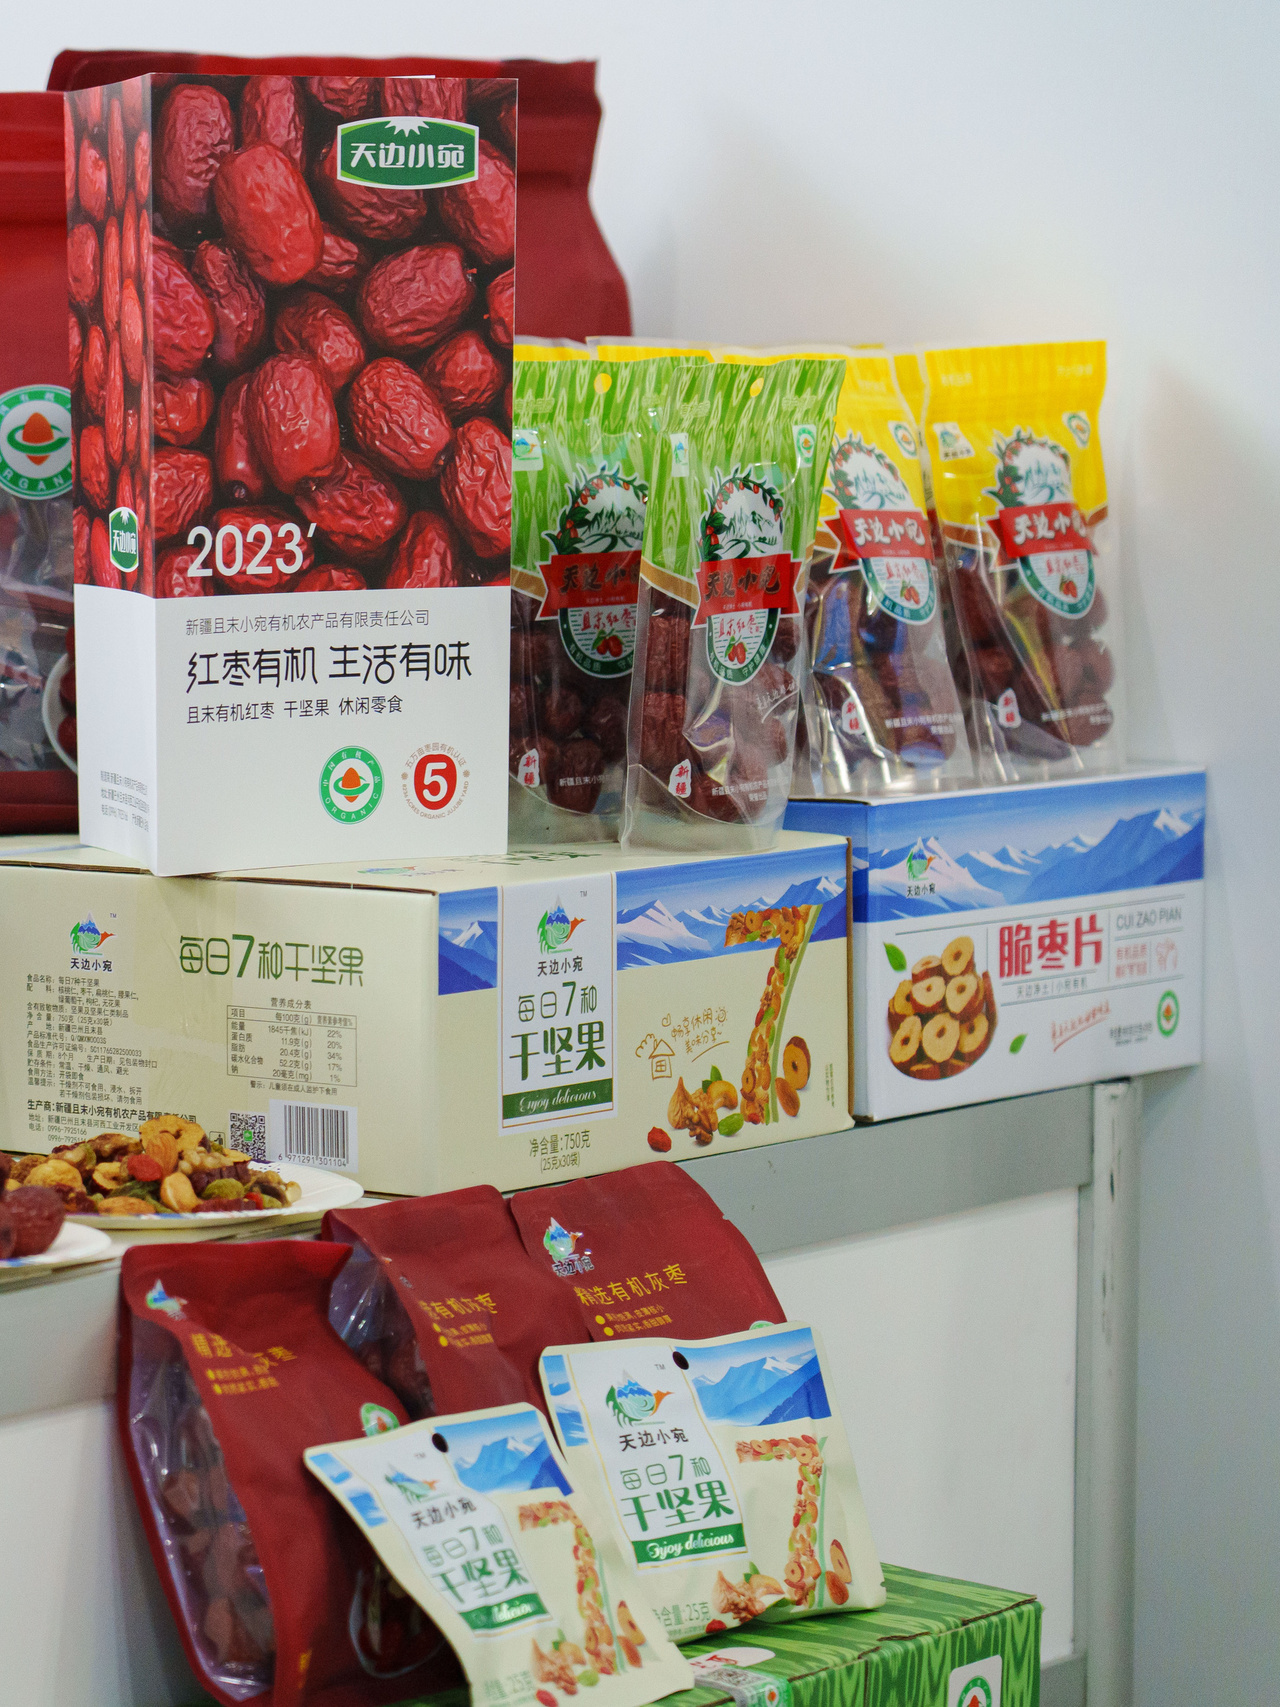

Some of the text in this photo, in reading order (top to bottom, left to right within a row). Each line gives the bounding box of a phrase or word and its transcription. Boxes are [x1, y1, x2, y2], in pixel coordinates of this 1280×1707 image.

[351, 142, 465, 169] 天边小宛
[185, 609, 430, 636] 新疆且末小宛有机农产品有限责任公司
[186, 641, 472, 693] 红枣有机 生活有味
[186, 695, 403, 724] 且末有机红枣 干坚果 休闲零食
[422, 761, 448, 802] 5
[325, 792, 379, 821] ORGANIC
[420, 811, 447, 820] ORGANIC
[461, 781, 470, 798] YARD
[179, 933, 364, 987] 每日7种干坚果
[999, 913, 1103, 979] 脆枣片
[70, 957, 113, 972] 天边小宛
[537, 955, 583, 977] 天边小宛
[231, 1008, 245, 1018] 项目
[271, 997, 312, 1010] 营养成分表
[517, 981, 597, 1023] 每日7种
[231, 1021, 246, 1031] 能量
[327, 1029, 342, 1039] 22%
[327, 1041, 342, 1050] 20%
[327, 1052, 342, 1061] 34%
[509, 1020, 606, 1082] 干坚果
[520, 1088, 597, 1115] Enjoy delicious
[529, 1128, 591, 1158] 净含量:750克
[619, 1427, 689, 1452] 天边小宛
[620, 1454, 711, 1491] 每日7种
[411, 1497, 477, 1530] 天边小宛
[621, 1480, 734, 1532] 干坚果
[685, 1529, 734, 1550] delicious
[430, 1547, 529, 1604] 干坚果
